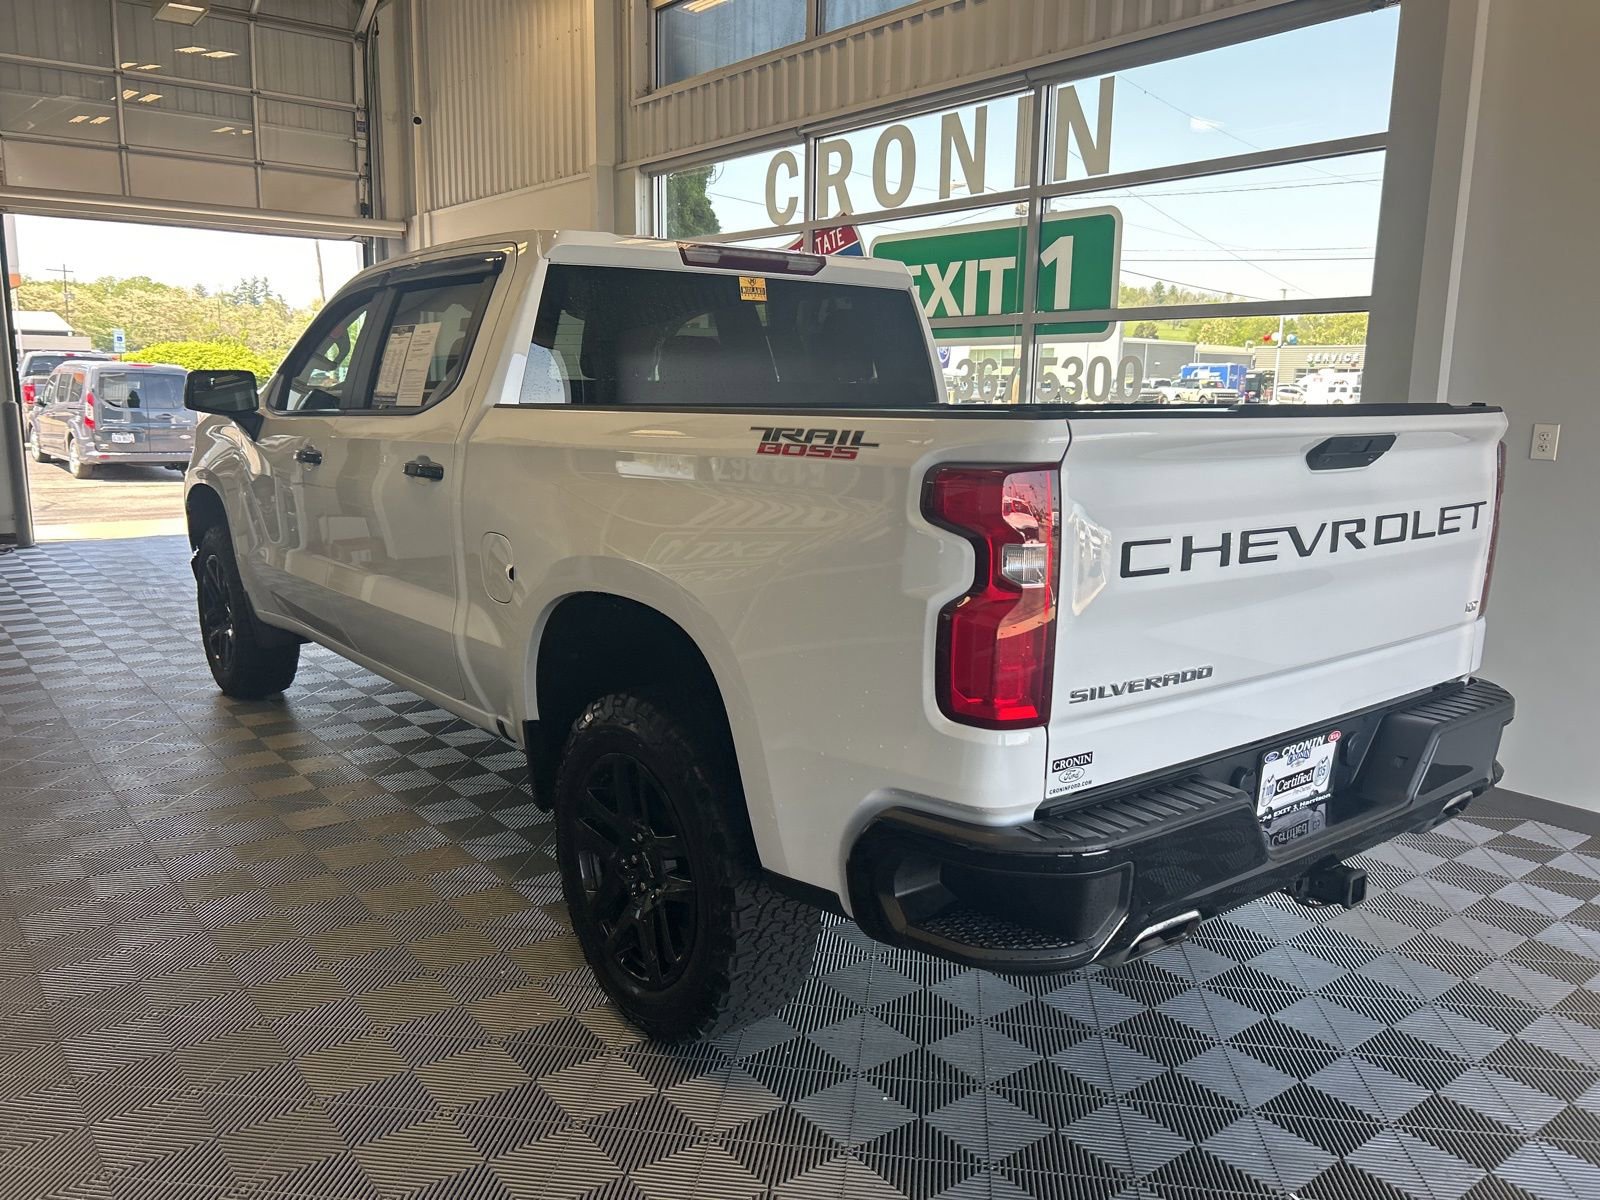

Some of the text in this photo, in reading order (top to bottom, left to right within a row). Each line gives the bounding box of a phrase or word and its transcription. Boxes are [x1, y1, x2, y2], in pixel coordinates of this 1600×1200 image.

[765, 75, 1115, 226] CRONIN
[1040, 235, 1074, 310] 1
[1306, 352, 1361, 363] SERVICE
[750, 426, 879, 447] TRAIL
[757, 441, 860, 460] BOSS
[1120, 501, 1487, 578] CHEVROLET
[1069, 665, 1214, 704] SILVERADO
[1281, 735, 1325, 757] CRONIN
[1053, 753, 1092, 770] CRONIN
[1276, 769, 1313, 792] Certified
